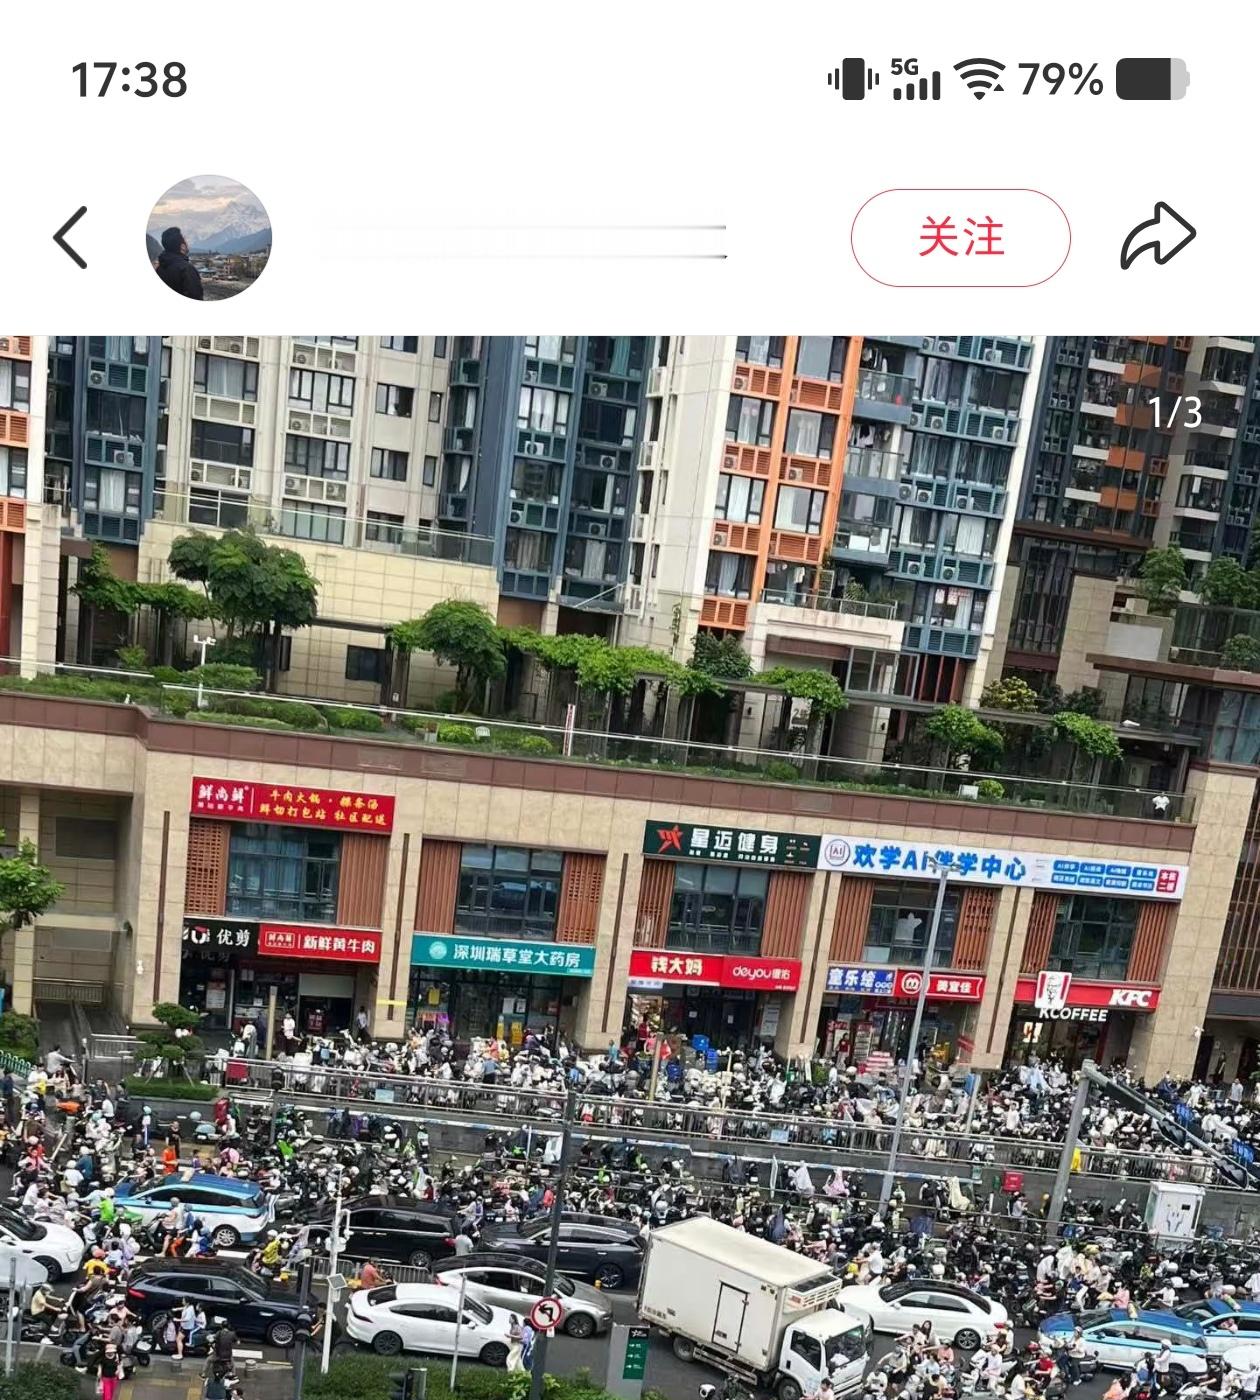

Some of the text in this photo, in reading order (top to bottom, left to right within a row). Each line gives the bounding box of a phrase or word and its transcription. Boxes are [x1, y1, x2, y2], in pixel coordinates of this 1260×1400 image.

[198, 784, 244, 804] 鲜尚鲜
[690, 828, 779, 854] 星迈健身
[216, 928, 251, 947] 优剪
[303, 934, 375, 954] 新鲜黄牛肉
[453, 943, 581, 969] 深圳瑞草堂大药房
[651, 955, 703, 977] 钱大妈
[936, 979, 973, 994] 美宜佳
[1109, 988, 1153, 1007] KFC
[1038, 1007, 1109, 1022] KCOFFEE
